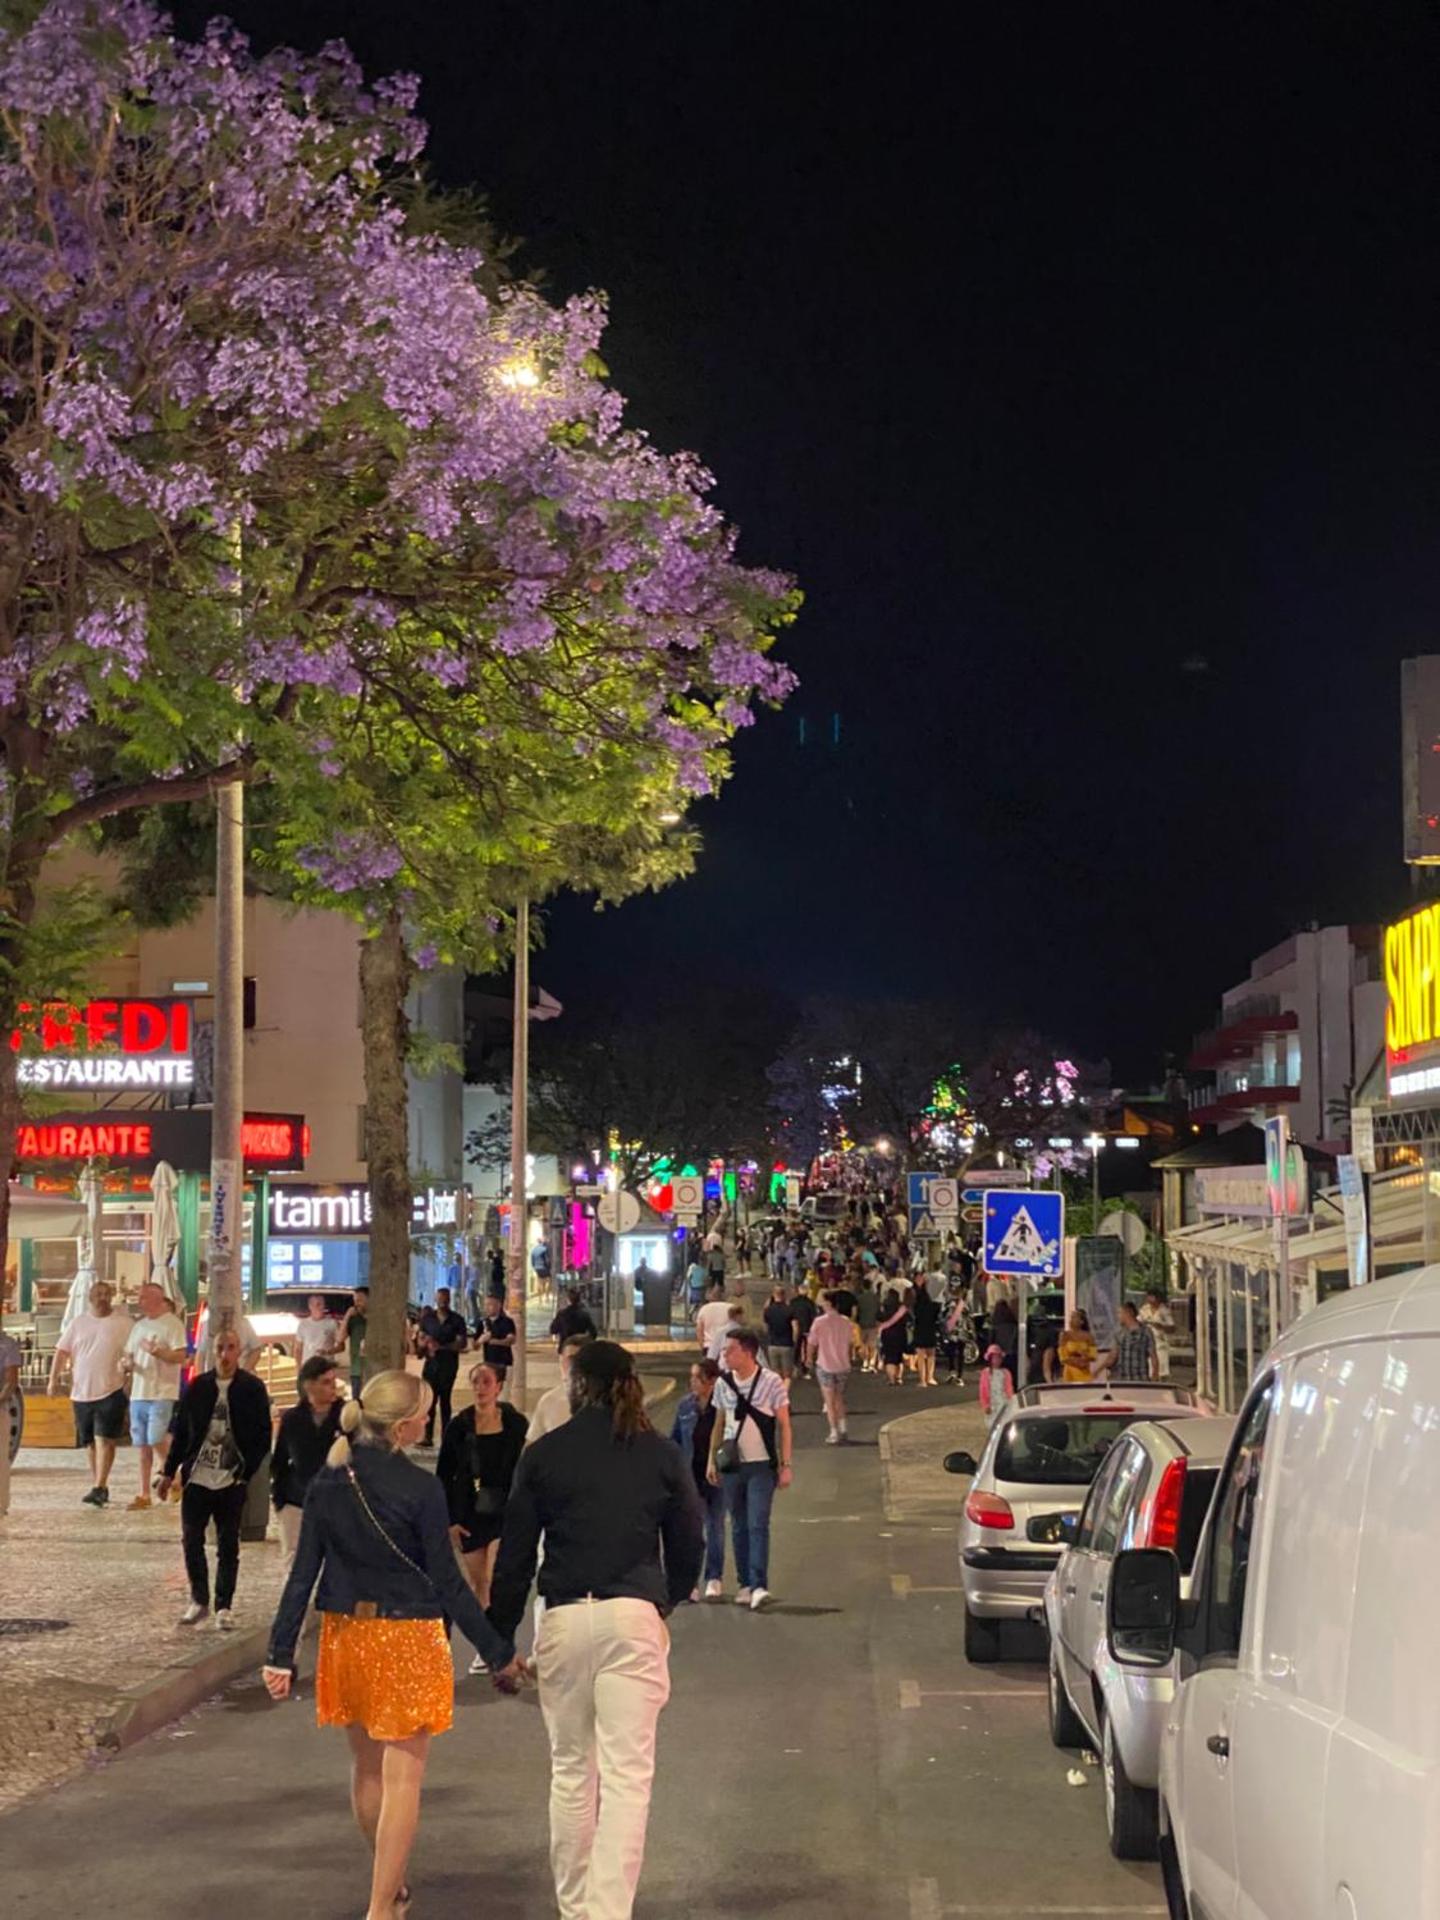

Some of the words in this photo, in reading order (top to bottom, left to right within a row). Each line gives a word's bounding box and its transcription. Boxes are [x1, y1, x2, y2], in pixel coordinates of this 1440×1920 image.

[11, 1001, 189, 1054] REDI
[19, 1059, 194, 1083] ESTAURANTE
[18, 1125, 150, 1155] AURANTE
